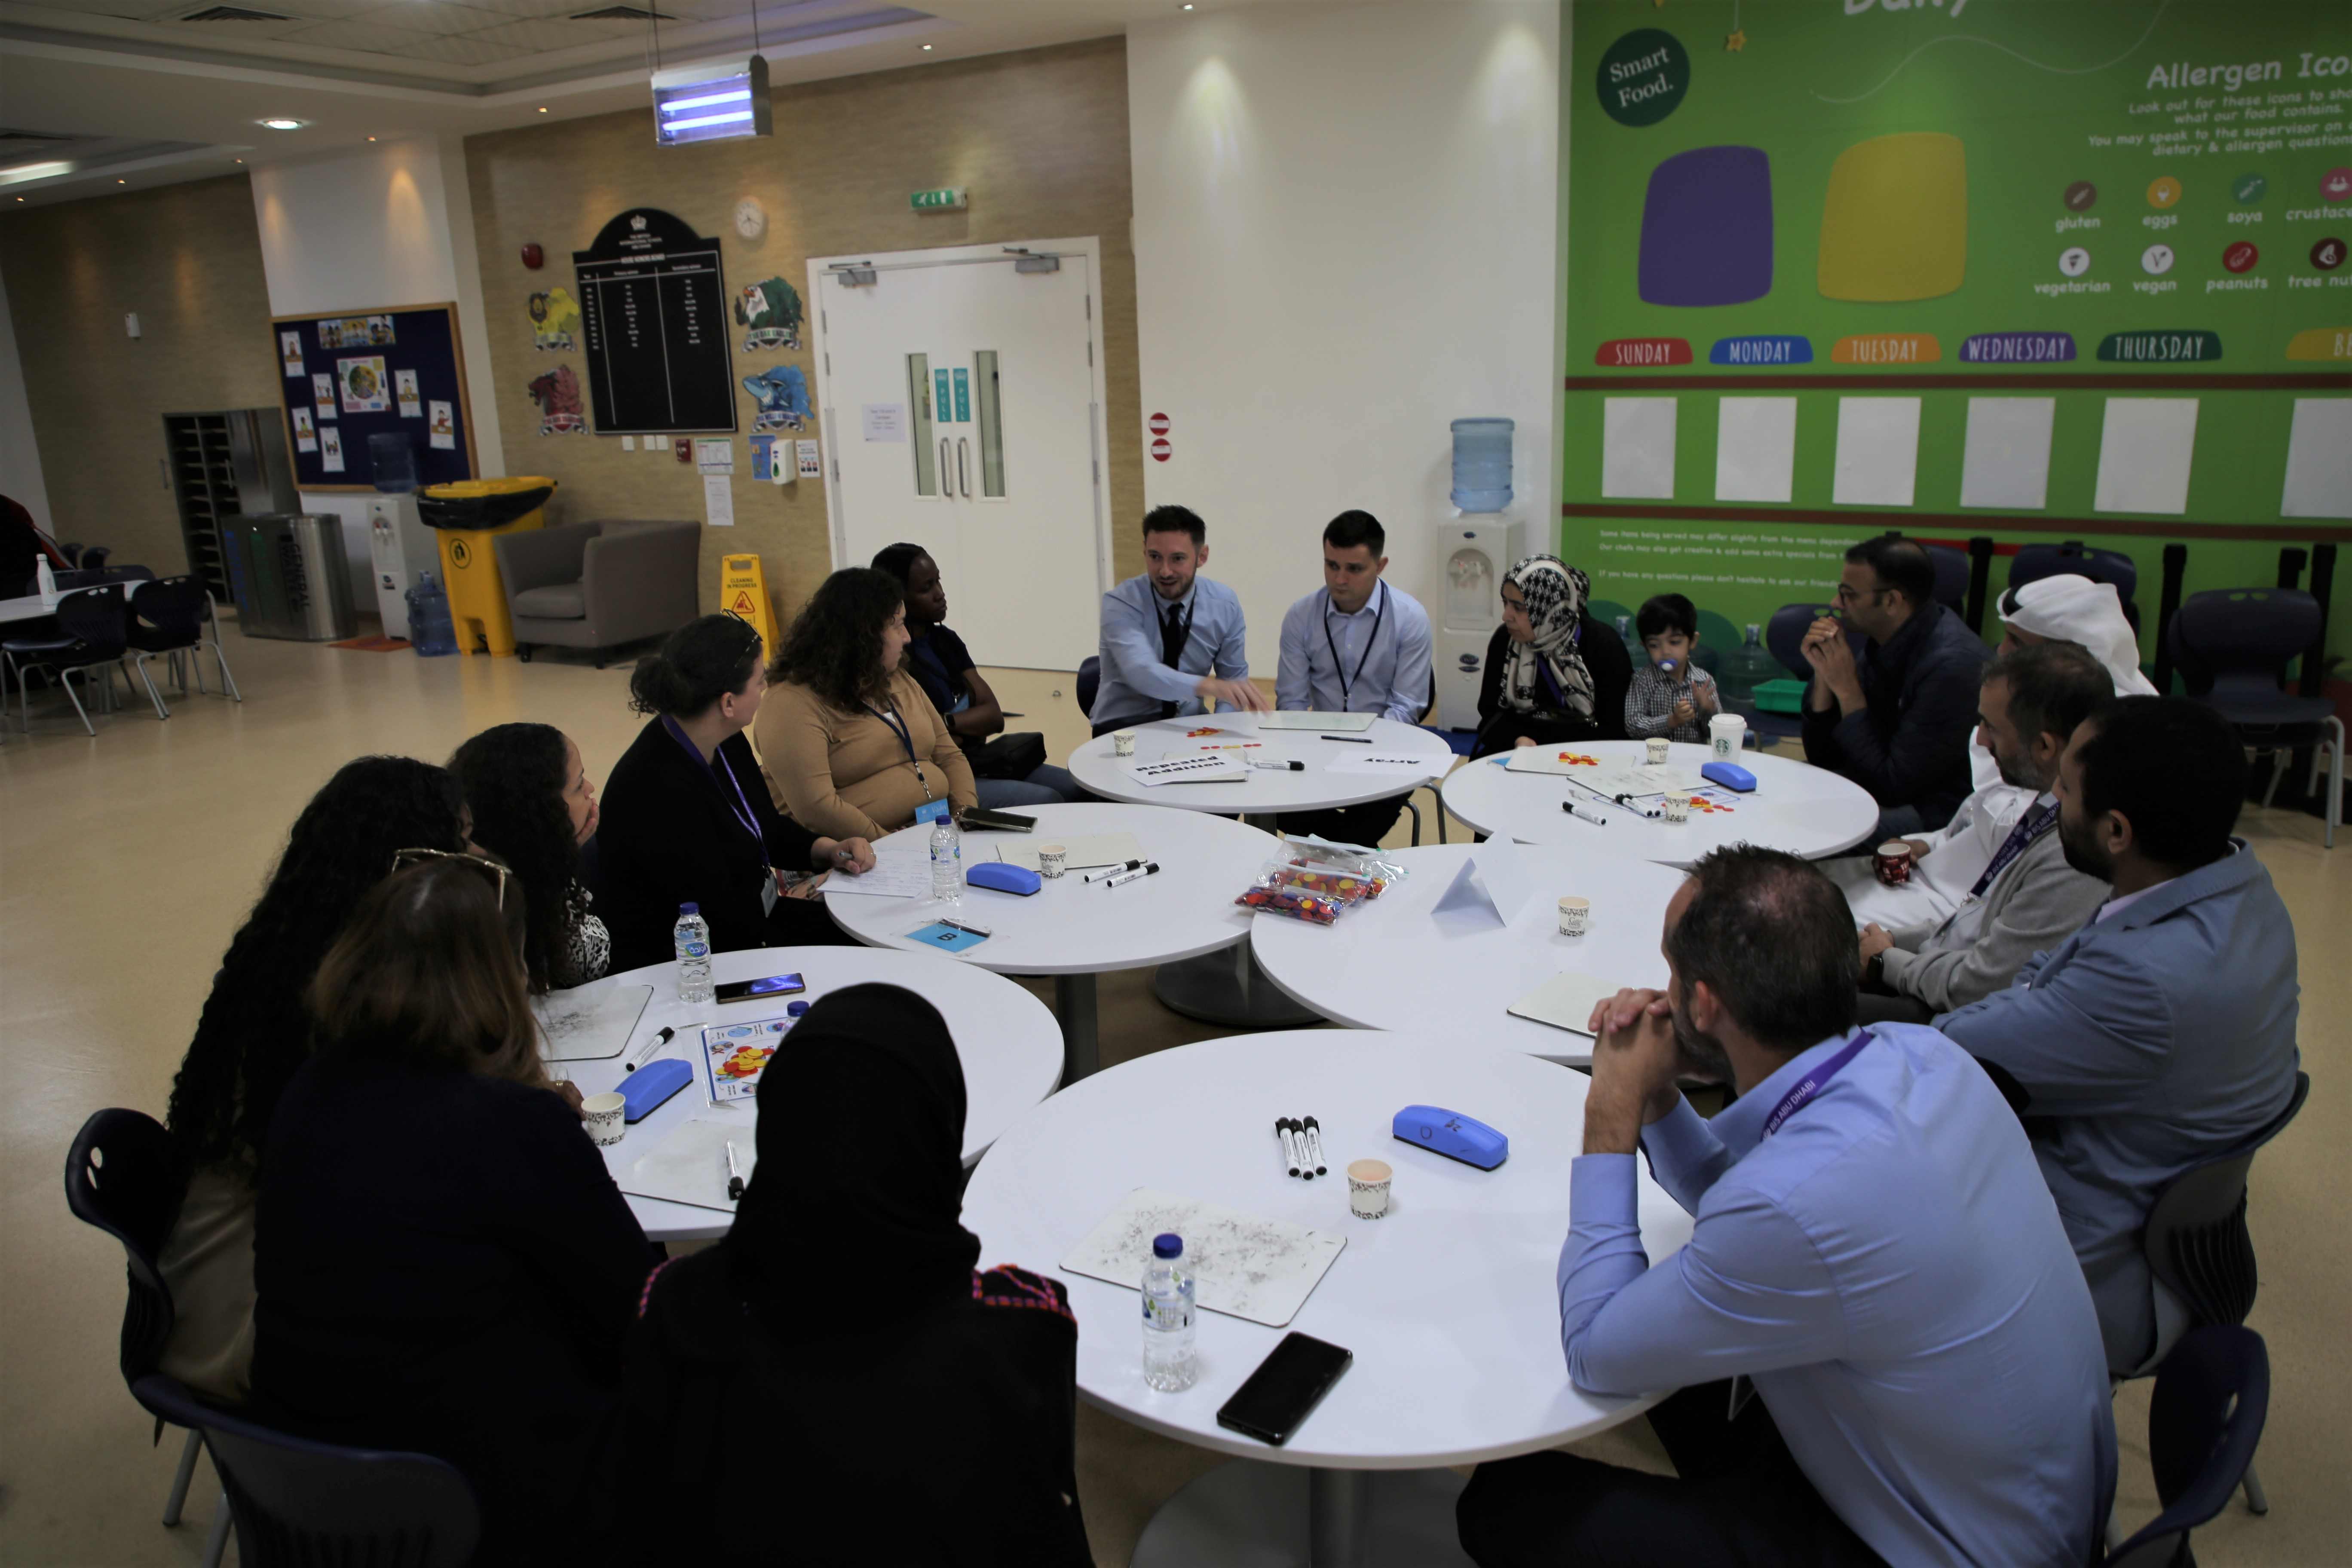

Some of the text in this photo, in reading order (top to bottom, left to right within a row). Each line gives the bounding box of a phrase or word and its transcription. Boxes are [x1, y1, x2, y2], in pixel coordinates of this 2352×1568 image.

[1609, 45, 1671, 83] Smart
[2147, 52, 2352, 91] Allergen Ico
[1617, 74, 1674, 108] Food.
[2129, 102, 2160, 114] Look
[2166, 100, 2188, 112] out
[2195, 98, 2215, 110] for
[2223, 96, 2261, 107] these
[2267, 92, 2302, 104] icons
[2309, 90, 2324, 101] to
[2174, 104, 2344, 124] what our food contains.
[2089, 136, 2111, 147] You
[2116, 135, 2144, 146] may
[2149, 132, 2187, 145] speak
[2195, 129, 2208, 140] to
[2216, 127, 2239, 138] the
[2244, 123, 2318, 137] supervisor
[2324, 122, 2342, 132] on
[2153, 144, 2202, 156] dietary
[2208, 142, 2218, 153] &
[2225, 137, 2283, 152] allergen
[2055, 217, 2101, 233] gluten
[2143, 214, 2178, 228] eggs
[2227, 211, 2263, 225] soya
[2034, 281, 2110, 297] vegetarian
[2133, 280, 2177, 294] vegan
[2206, 277, 2268, 293] peanuts
[2288, 275, 2321, 288] tree
[1615, 343, 1670, 365] SUNDAY
[1729, 341, 1790, 363] MONDAY
[1851, 340, 1918, 361] TUESDAY
[1968, 337, 2066, 361] WEDNESDAY
[2115, 336, 2203, 359] THURSDAY
[1730, 534, 1757, 543] slightly
[1669, 546, 1681, 555] get
[1786, 551, 1816, 559] specials
[291, 544, 311, 607] GENERAL
[1657, 573, 1689, 582] questions
[1691, 574, 1714, 582] please
[1136, 755, 1219, 771] Repeated
[1148, 761, 1225, 775] Addition
[1778, 1100, 1793, 1120] ABU
[1790, 1080, 1816, 1104] DHABI
